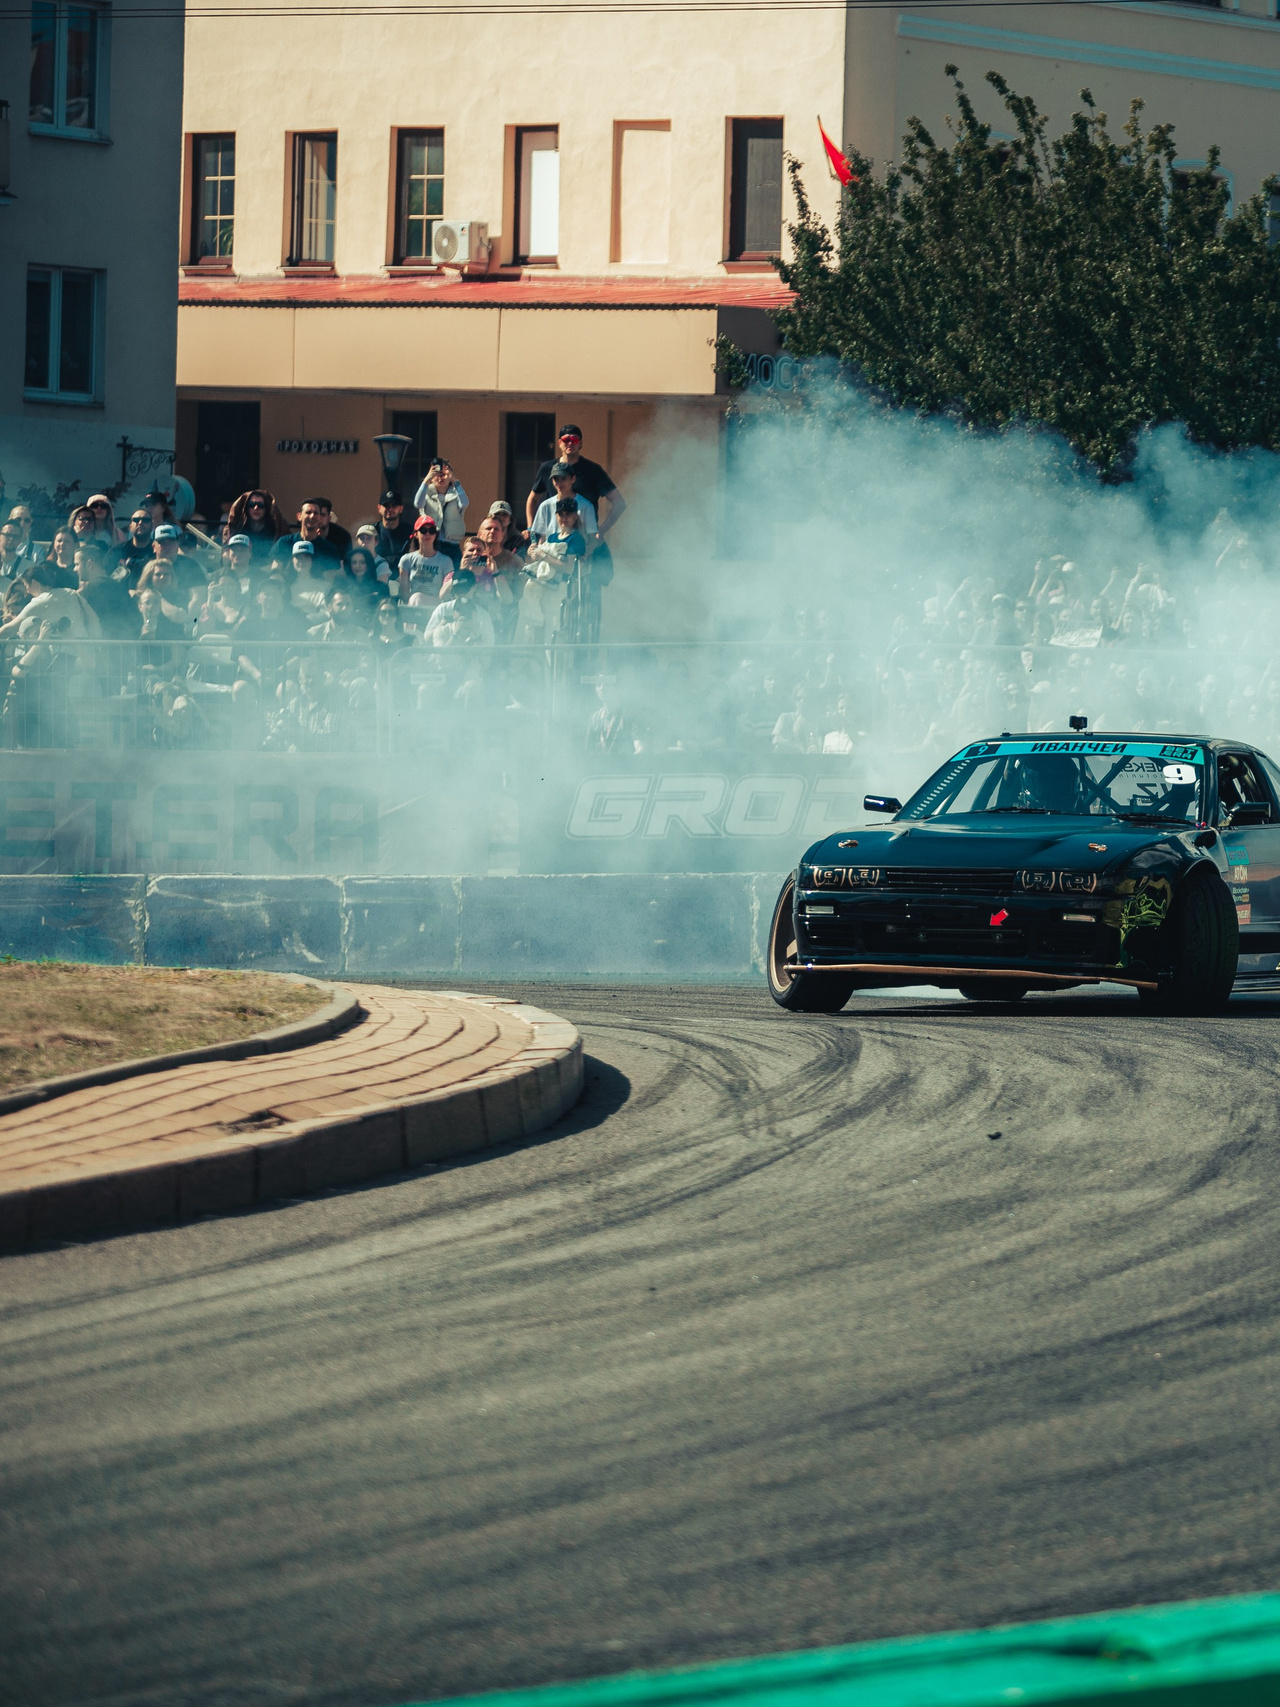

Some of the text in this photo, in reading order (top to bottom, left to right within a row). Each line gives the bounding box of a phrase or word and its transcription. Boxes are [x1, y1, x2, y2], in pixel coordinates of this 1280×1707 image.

[276, 440, 355, 454] ПРОХОДНАЯ
[977, 745, 989, 756] 9
[1162, 764, 1197, 785] 9
